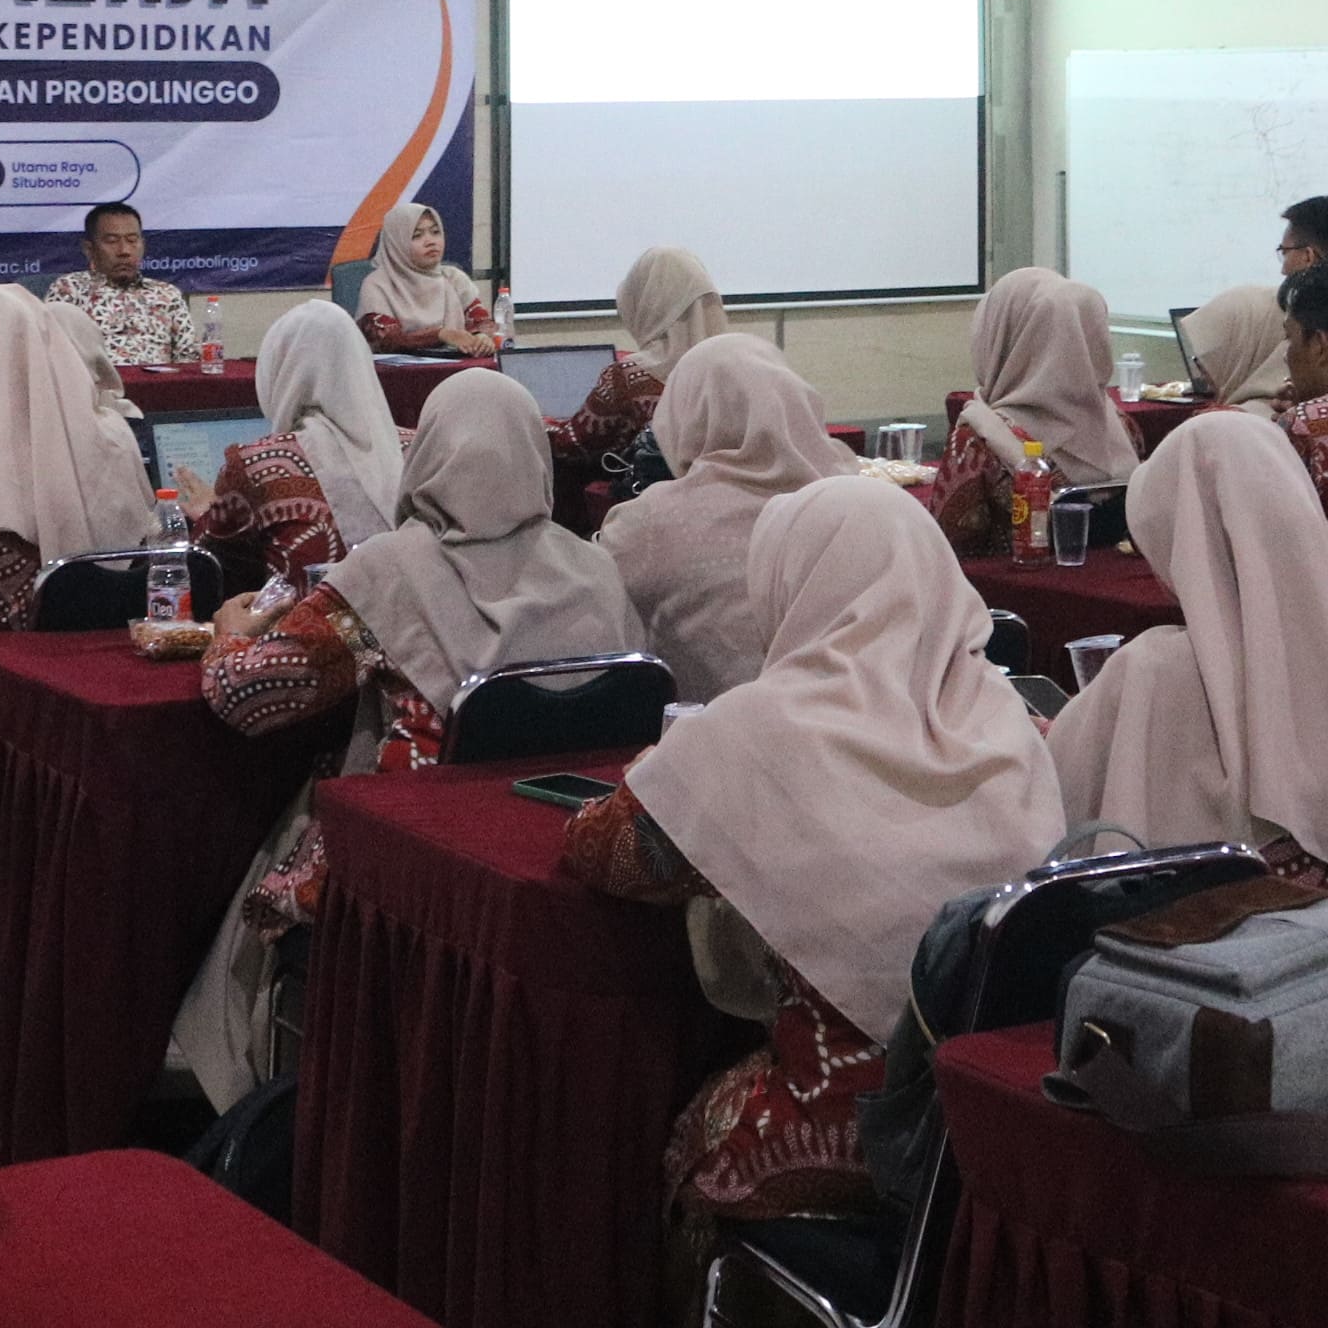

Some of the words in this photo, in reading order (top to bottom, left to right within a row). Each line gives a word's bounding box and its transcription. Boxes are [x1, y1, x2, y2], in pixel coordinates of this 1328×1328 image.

[45, 80, 259, 105] PROBOLINGGO
[12, 161, 57, 173] Utama
[61, 161, 98, 175] Raya,
[12, 176, 81, 189] Situbondo
